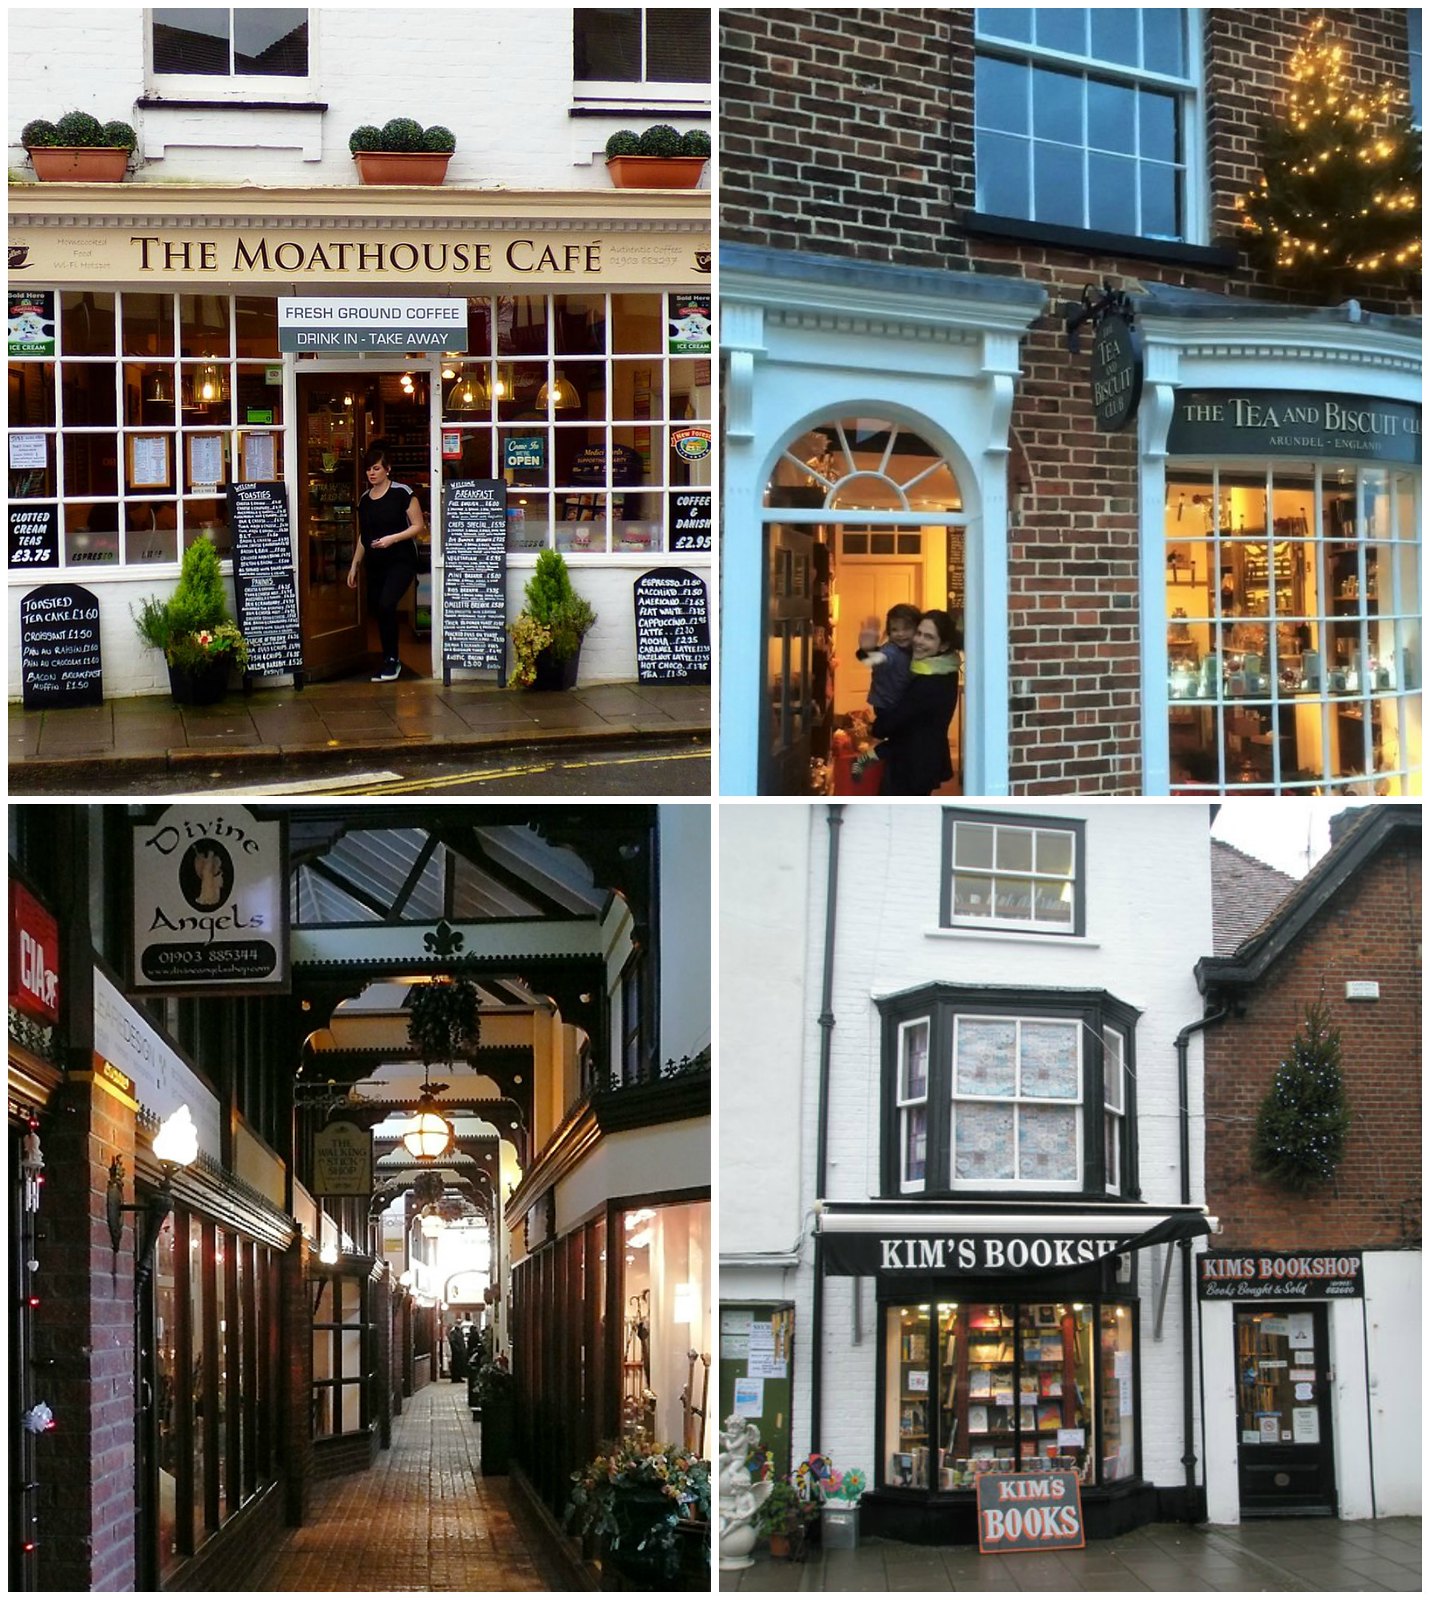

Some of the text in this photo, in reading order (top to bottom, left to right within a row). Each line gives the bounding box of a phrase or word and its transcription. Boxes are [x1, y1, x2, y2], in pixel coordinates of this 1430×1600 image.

[131, 236, 219, 272] THE
[232, 238, 492, 273] MOATHOUSE
[285, 307, 459, 320] FRESH GROUND COFFEE
[297, 333, 340, 345] DRINK
[344, 333, 358, 345] IN
[369, 333, 402, 345] TAKE
[406, 333, 448, 345] AWAY
[1183, 404, 1224, 422] THE
[1227, 398, 1281, 429] TEA
[1282, 406, 1320, 424] AND
[1325, 401, 1399, 436] BISCUIT
[1268, 436, 1324, 448] ARUNDEL
[1335, 440, 1382, 452] ENGLAND
[508, 456, 540, 465] OPEN
[237, 490, 272, 500] TOASTIES
[454, 489, 495, 500] BREAKFAST
[676, 496, 711, 506] COFFEE
[11, 512, 50, 523] CLOTTED
[689, 508, 698, 517] &
[13, 523, 47, 535] CREAM
[19, 535, 42, 546] TEAS
[675, 536, 711, 549] £2.95
[11, 548, 51, 562] £3.75
[24, 596, 73, 611] TOASTED
[22, 613, 43, 625] TEA
[45, 611, 71, 622] CAKE
[640, 628, 664, 636] LATTE
[145, 816, 260, 855] Divine
[148, 903, 265, 946] Angels
[158, 951, 203, 964] 01903
[318, 1148, 367, 1157] WALKING
[327, 1157, 358, 1166] STICK
[983, 1239, 1131, 1268] BOOKSH
[1258, 1257, 1361, 1279] BOOKSHOP
[982, 1505, 1080, 1543] BOOKS
